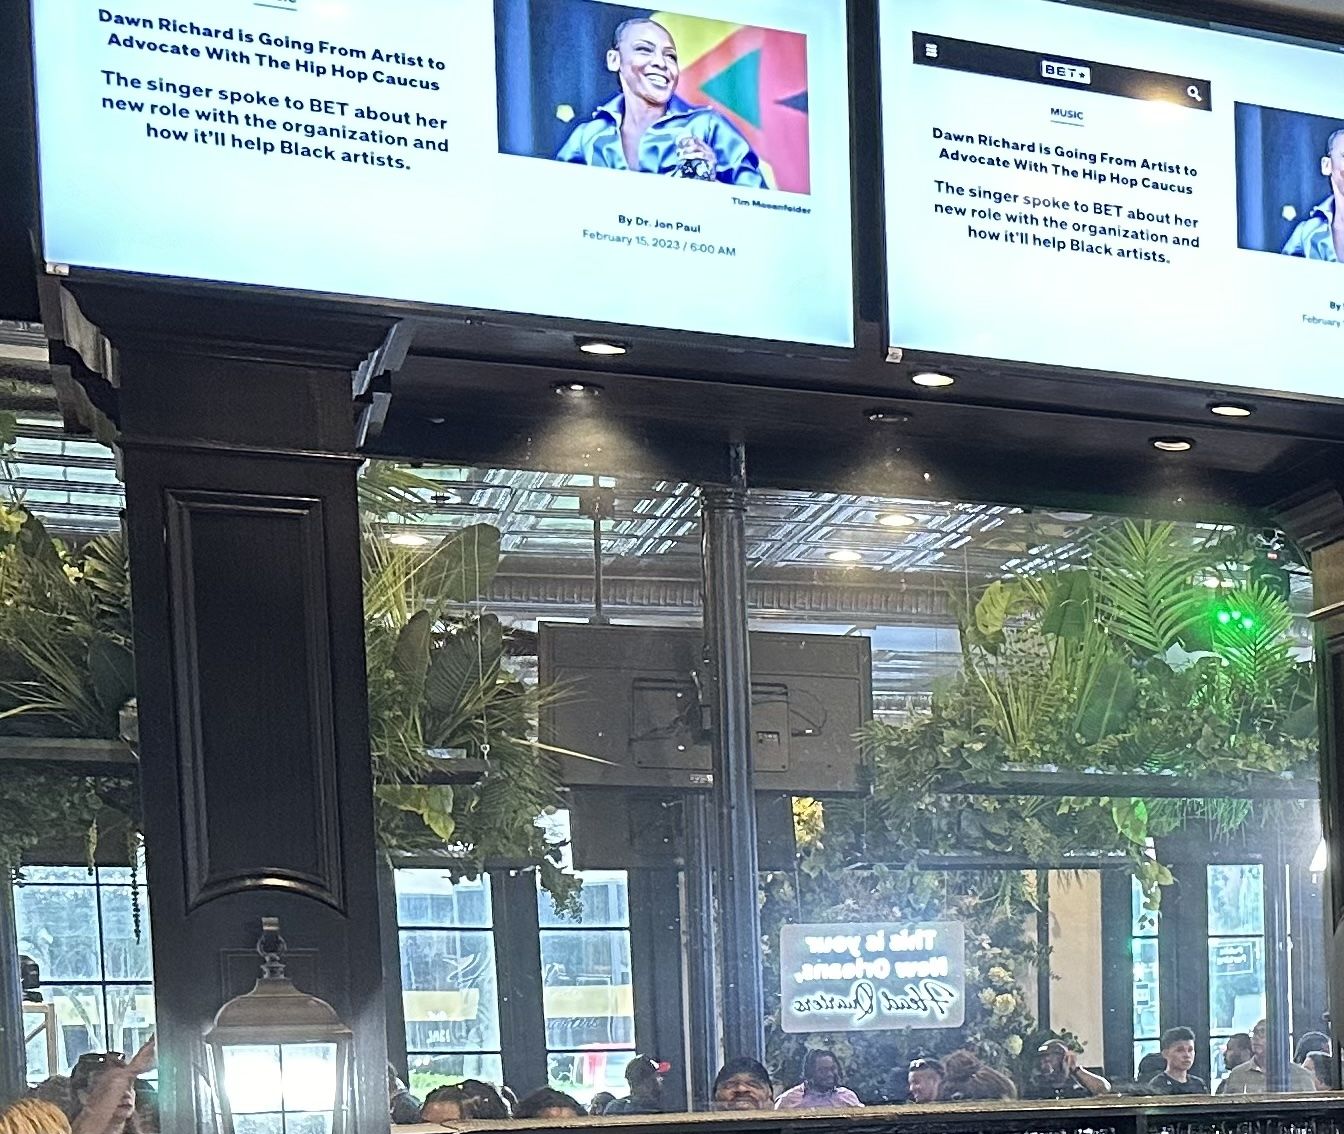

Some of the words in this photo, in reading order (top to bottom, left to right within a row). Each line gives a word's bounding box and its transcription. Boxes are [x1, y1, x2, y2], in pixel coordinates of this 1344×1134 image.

[98, 8, 153, 29] Dawn
[158, 17, 233, 40] Richard
[238, 29, 254, 43] is
[258, 32, 313, 54] Going
[318, 40, 366, 59] From
[371, 48, 423, 67] Artist
[428, 57, 445, 70] to
[107, 33, 200, 57] Advocate
[205, 46, 250, 64] With
[254, 53, 290, 70] The
[295, 58, 326, 77] Hip
[331, 64, 368, 83] Hop
[372, 70, 440, 90] Caucus
[1046, 65, 1076, 77] BET
[100, 70, 141, 88] The
[147, 78, 213, 98] singer
[218, 90, 279, 107] spoke
[284, 96, 304, 110] to
[310, 98, 349, 116] BET
[354, 106, 410, 125] about
[416, 112, 447, 129] her
[1051, 108, 1084, 120] MUSIC
[102, 97, 144, 112] new
[150, 103, 190, 118] role
[195, 108, 239, 125] with
[244, 113, 276, 129] the
[282, 121, 407, 147] organization
[413, 138, 448, 152] and
[146, 122, 188, 141] how
[194, 128, 225, 146] it'll
[231, 133, 275, 155] help
[280, 140, 335, 160] Black
[341, 151, 410, 170] artists.
[932, 127, 974, 144] Dawn
[978, 134, 1035, 152] Richard
[1039, 143, 1050, 155] is
[1054, 146, 1096, 164] Going
[1100, 152, 1136, 168] From
[1140, 158, 1180, 174] Artist
[1184, 166, 1197, 176] to
[939, 148, 1010, 168] Advocate
[1014, 158, 1048, 173] With
[1051, 163, 1078, 178] The
[1082, 168, 1106, 184] Hip
[1110, 172, 1138, 188] Hop
[1141, 177, 1192, 194] Caucus
[618, 214, 632, 226] By
[654, 219, 673, 229] Jon
[676, 222, 700, 233] Paul
[934, 180, 964, 196] The
[969, 186, 1018, 203] singer
[1023, 196, 1070, 210] spoke
[1074, 200, 1088, 212] to
[1093, 202, 1123, 217] BET
[1127, 208, 1170, 224] about
[1174, 214, 1198, 228] her
[934, 204, 966, 216] new
[971, 208, 1001, 220] role
[1005, 212, 1038, 226] with
[1043, 216, 1067, 230] the
[1072, 222, 1168, 243] organization
[1172, 236, 1199, 248] and
[583, 229, 632, 245] February
[635, 236, 649, 246] 15,
[652, 237, 680, 250] 2023
[690, 242, 714, 254] 6:00
[717, 246, 735, 256] AM
[968, 225, 1000, 240] how
[1004, 230, 1028, 244] it'll
[1033, 233, 1066, 252] help
[1070, 238, 1112, 256] Black
[1116, 248, 1170, 263] artists.
